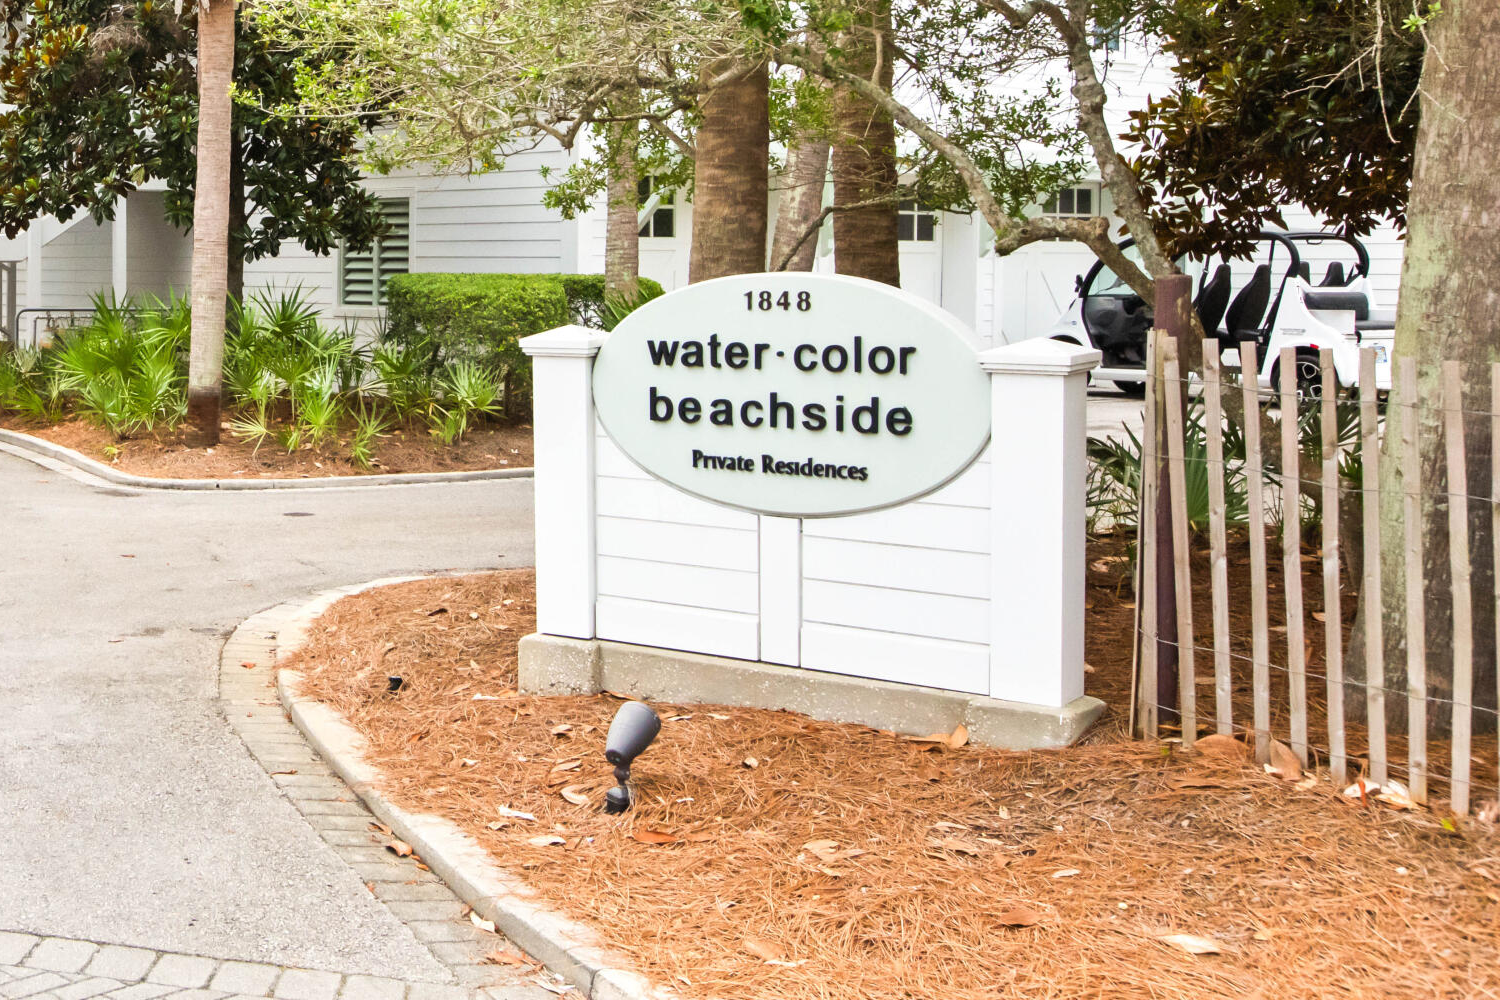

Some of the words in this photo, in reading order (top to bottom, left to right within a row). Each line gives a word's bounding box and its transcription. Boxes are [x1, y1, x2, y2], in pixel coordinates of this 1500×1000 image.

[743, 290, 812, 312] 1848
[649, 386, 914, 437] beachside
[691, 449, 755, 473] Private
[760, 454, 869, 482] Residences
